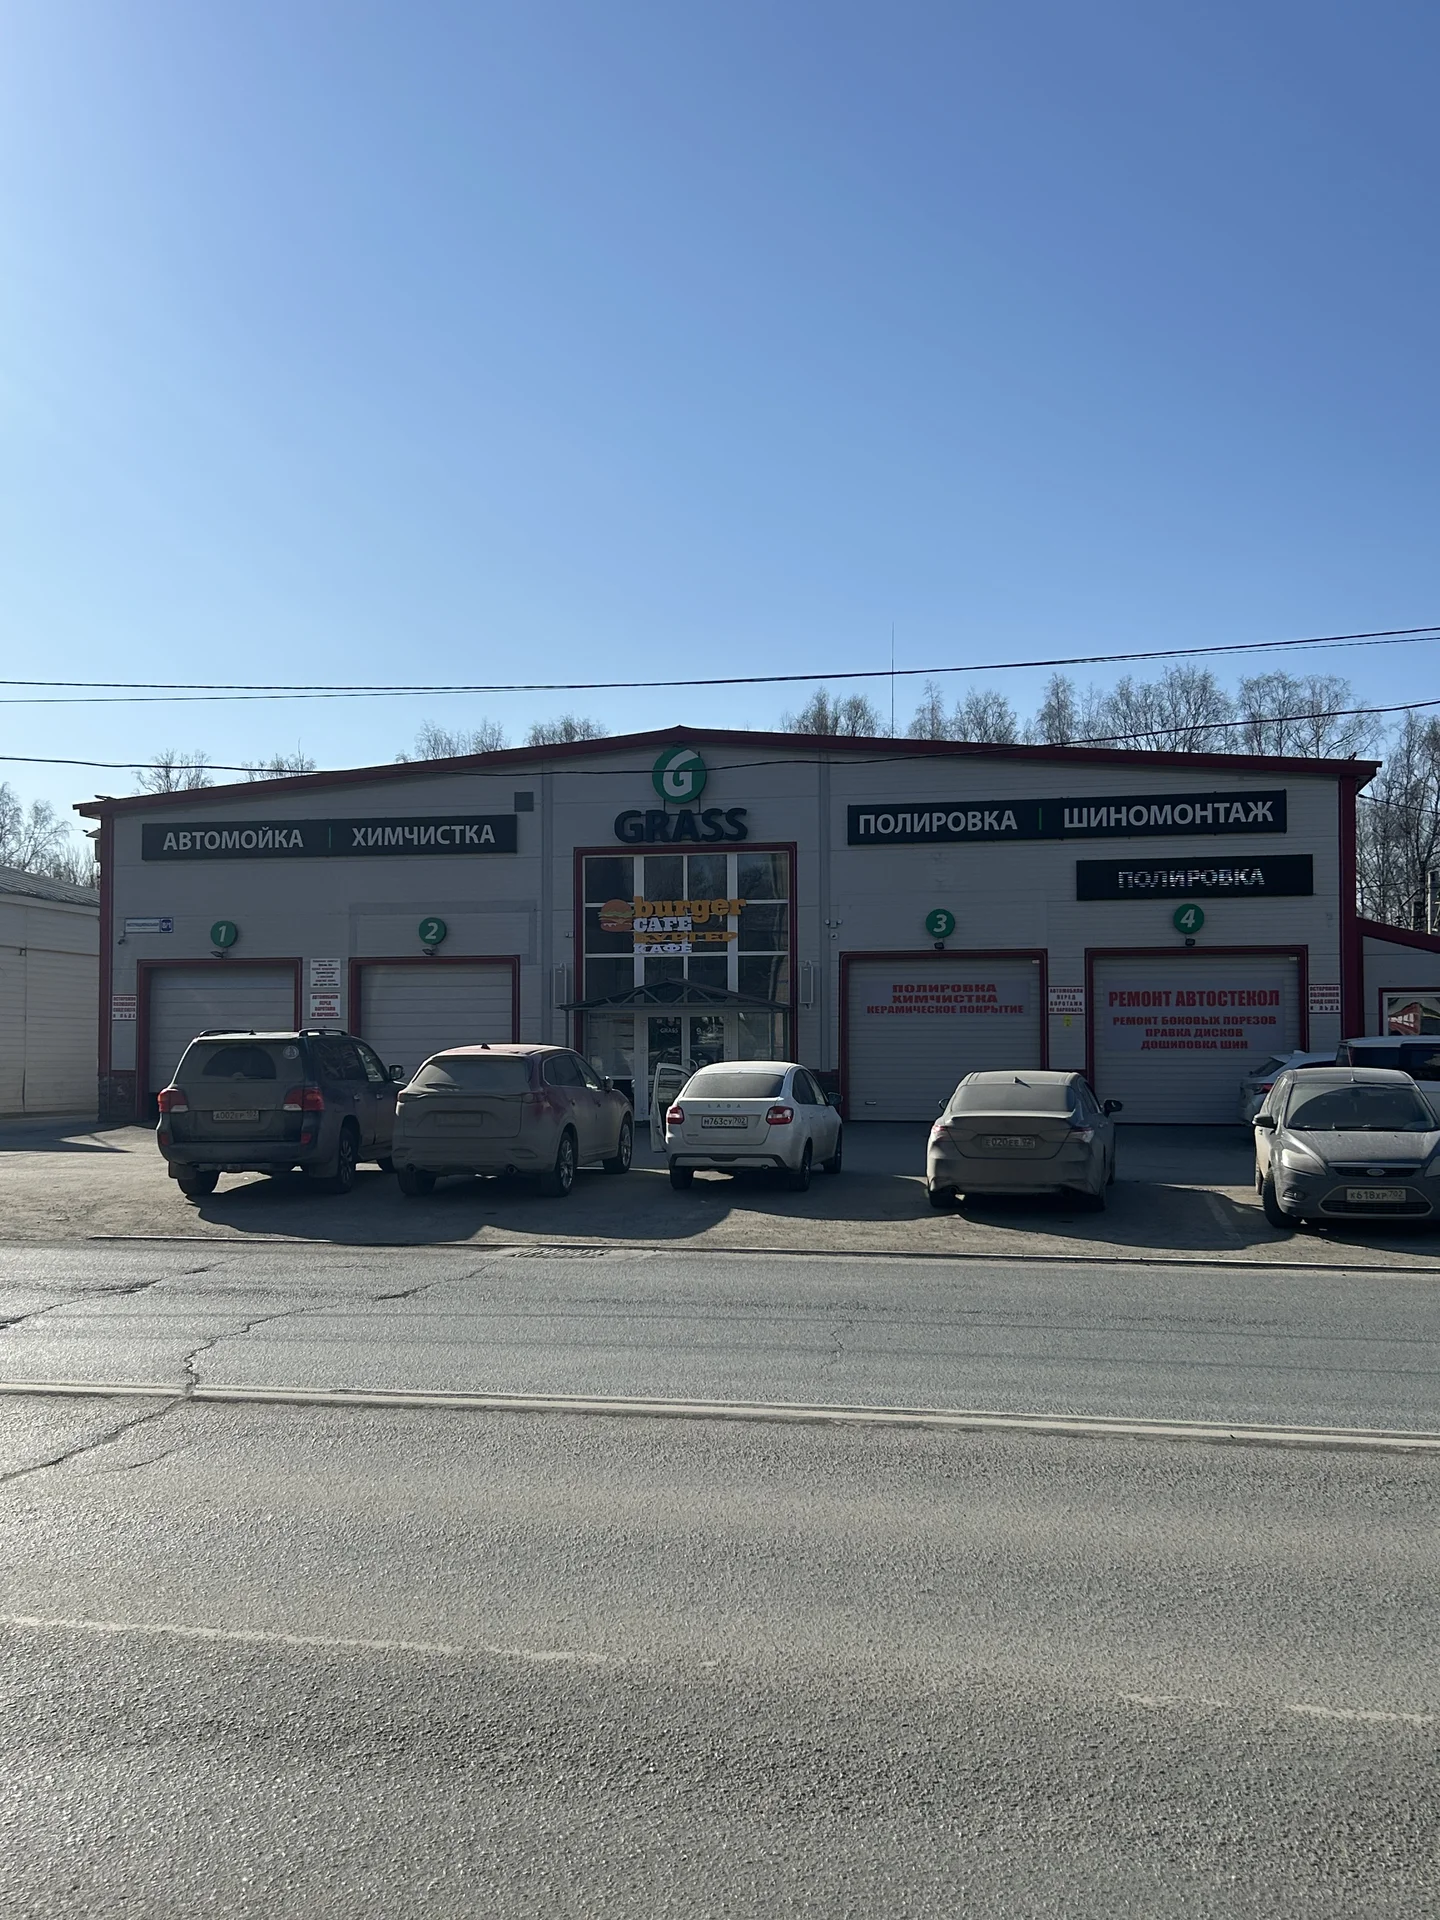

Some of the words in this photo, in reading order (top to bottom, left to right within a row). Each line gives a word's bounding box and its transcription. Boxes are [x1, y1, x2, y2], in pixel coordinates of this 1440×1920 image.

[663, 749, 699, 797] G
[614, 808, 749, 843] GRASS
[859, 810, 1018, 835] ПОЛИРОВКА
[1063, 801, 1274, 829] ШИНОМОНТАЖ
[163, 826, 304, 851] АВТОМОЙКА
[351, 824, 496, 847] ХИМЧИСТКА
[1118, 868, 1265, 888] ПОЛИРОВКА
[634, 896, 747, 923] burger
[1180, 909, 1195, 927] 4
[426, 923, 438, 940] 2
[634, 917, 692, 932] CAFE
[933, 914, 948, 932] 3
[218, 925, 227, 942] 1
[634, 932, 738, 943] БУРГЕР
[633, 944, 692, 954] КАФЕ
[892, 984, 997, 993] ПОЛИРОВКА
[892, 994, 998, 1003] ХИМЧИСТКА
[1109, 991, 1172, 1007] РЕМОНТ
[1175, 990, 1280, 1006] АВТОСТЕКОЛ
[867, 1005, 957, 1014] КЕРАМИЧЕСКОЕ
[959, 1005, 1024, 1014] ПОКРЫТИЕ
[1113, 1016, 1158, 1025] РЕМОНТ
[1161, 1016, 1220, 1025] БОКОВЫХ
[1223, 1016, 1277, 1025] ПОРЕЗОВ
[1145, 1028, 1191, 1037] ПРАВКА
[1194, 1028, 1243, 1038] ДИСКОВ
[1141, 1040, 1217, 1050] ДОШИПОВКА
[1220, 1040, 1249, 1049] ШИН
